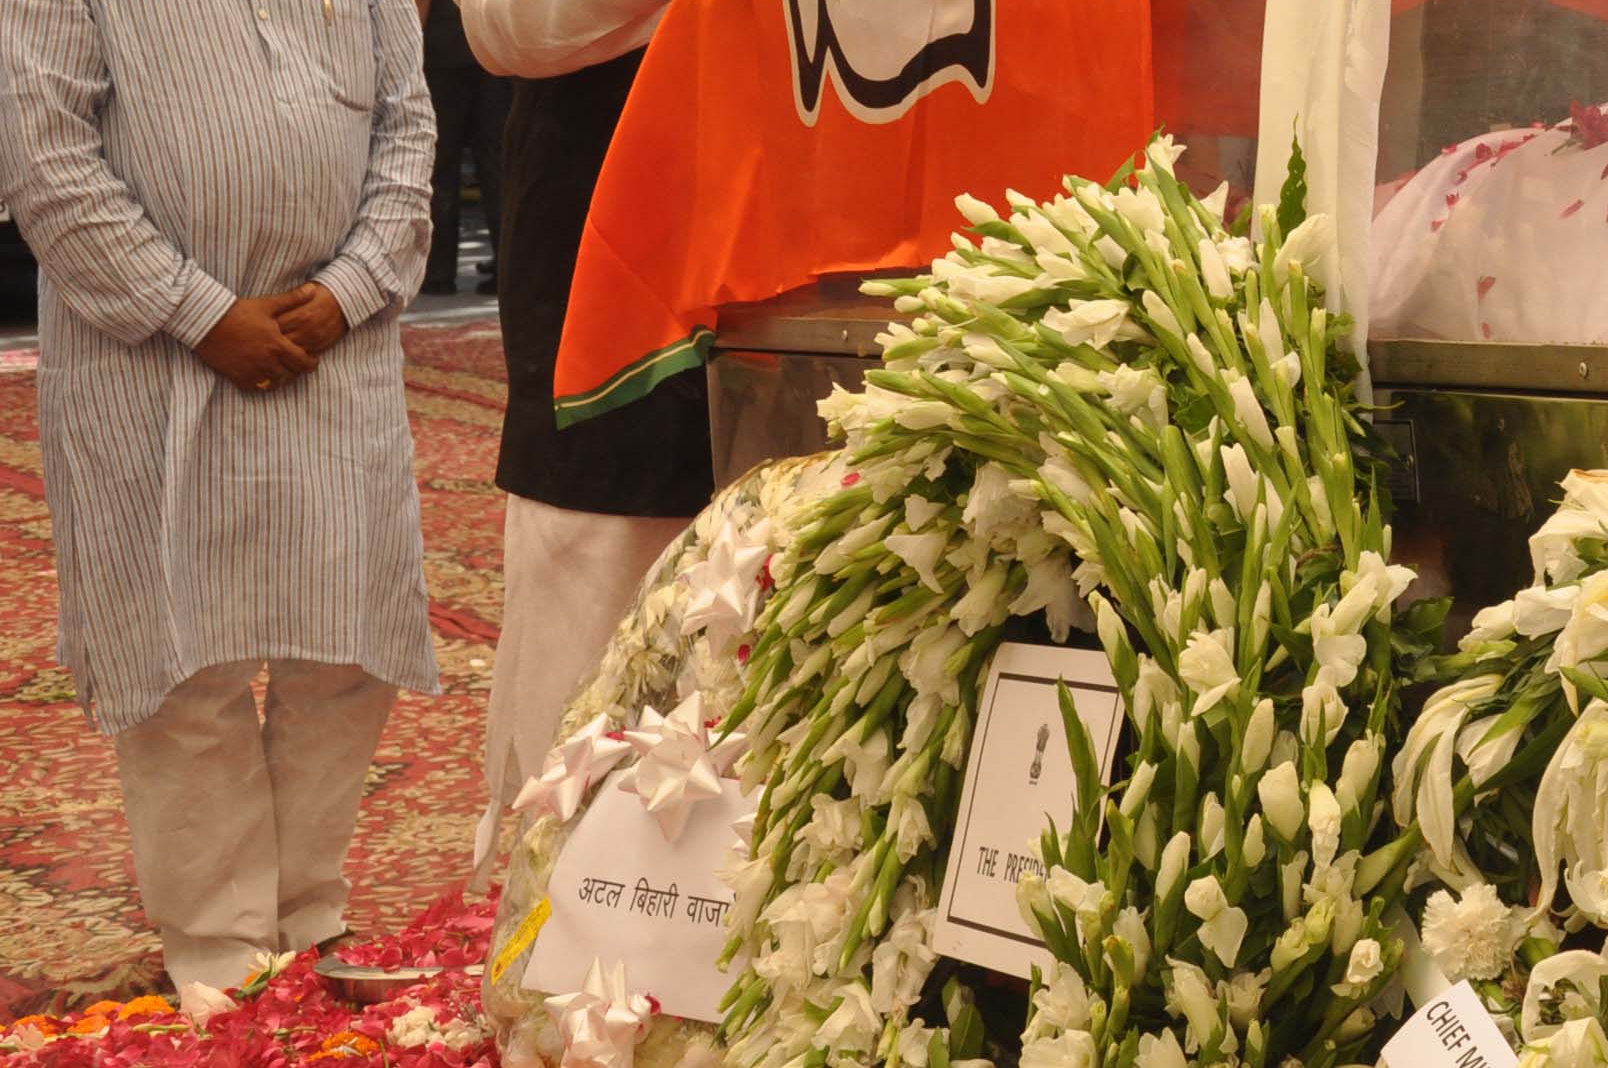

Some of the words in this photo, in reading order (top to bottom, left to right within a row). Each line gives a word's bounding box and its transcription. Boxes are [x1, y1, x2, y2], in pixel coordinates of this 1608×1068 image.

[976, 846, 999, 878] THE
[578, 877, 627, 909] अटल
[629, 876, 681, 919] बिहारी
[1426, 1001, 1471, 1051] CHIEF
